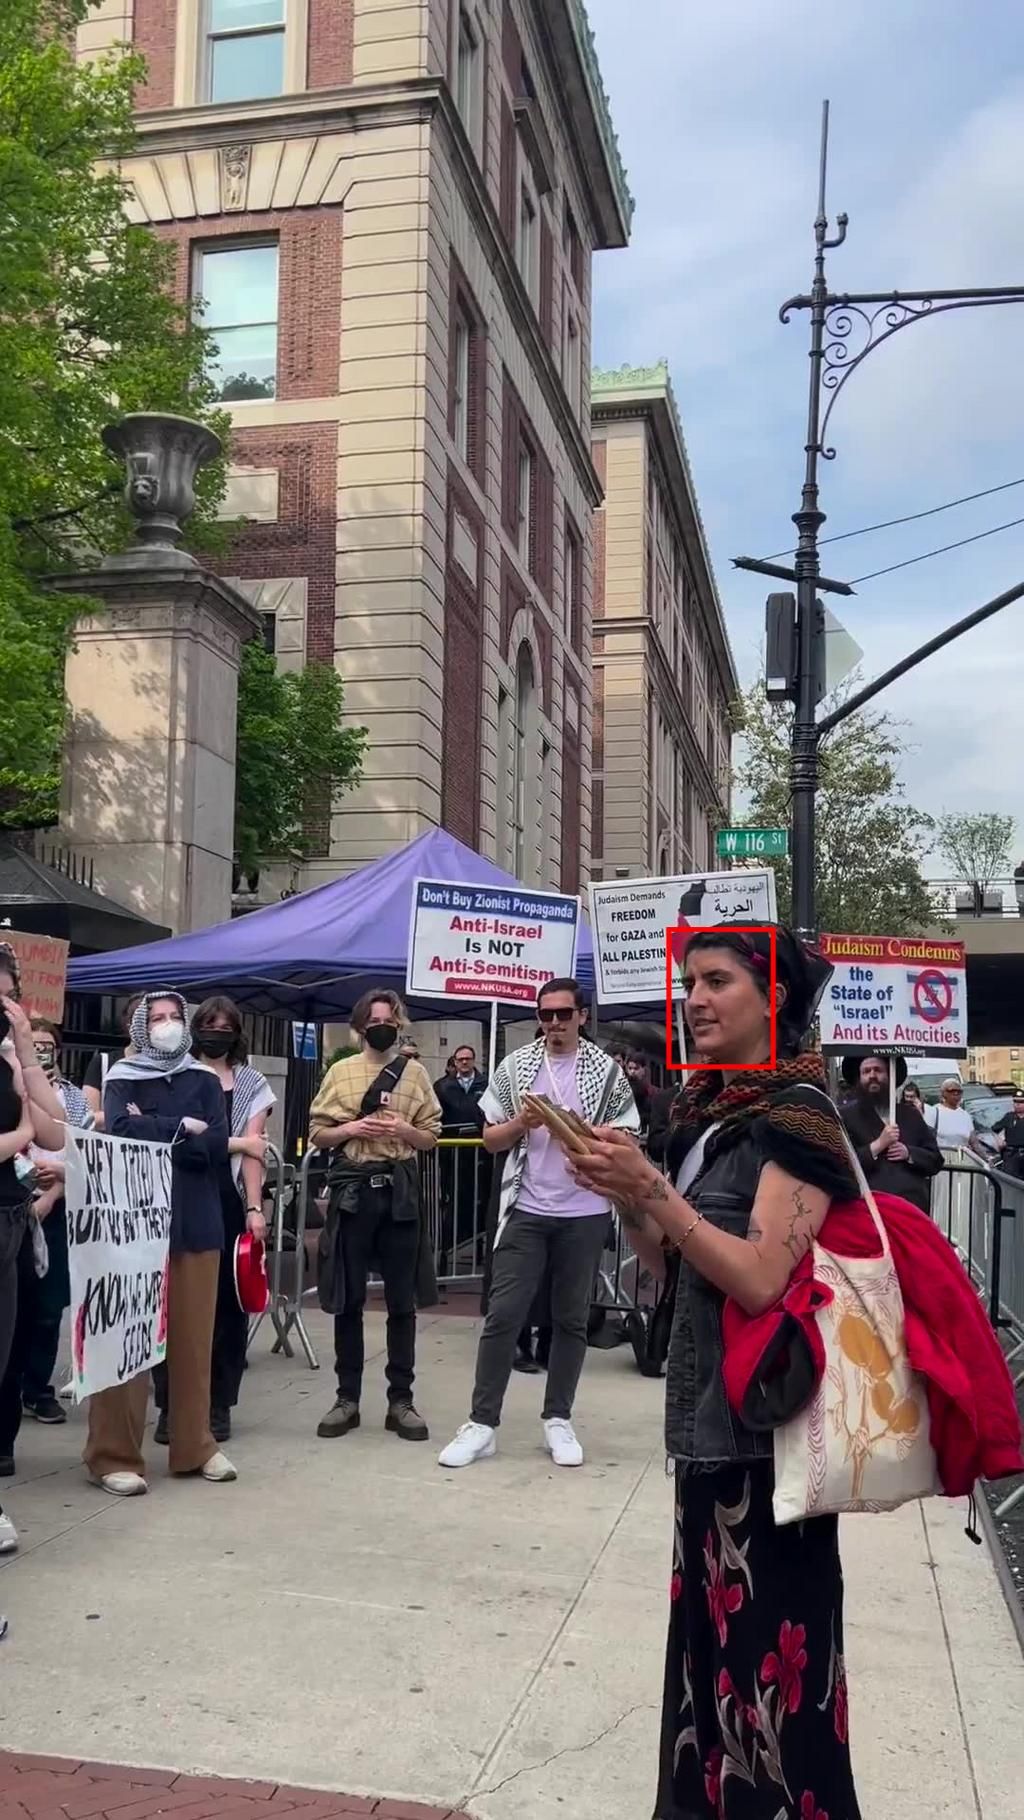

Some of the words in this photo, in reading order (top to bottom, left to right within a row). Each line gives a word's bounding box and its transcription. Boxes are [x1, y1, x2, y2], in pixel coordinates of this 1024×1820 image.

[726, 833, 737, 851] W
[745, 833, 765, 851] 116
[772, 833, 782, 844] St
[422, 887, 449, 905] Don't
[453, 891, 473, 909] Buy
[474, 894, 511, 911] Zionist
[513, 898, 573, 919] Propaganda
[598, 893, 629, 905] Judaism
[630, 890, 666, 902] Demands
[611, 909, 656, 922] FREEDOM
[714, 898, 753, 917] الحرية
[449, 915, 543, 939] Anti-Israel
[606, 932, 619, 943] for
[621, 930, 646, 941] GAZA
[648, 929, 665, 939] and
[465, 938, 481, 953] Is
[489, 940, 525, 957] NOT
[602, 952, 619, 962] ALL
[621, 948, 667, 962] PALESTIN
[824, 936, 884, 956] Judaism
[888, 939, 961, 962] Condemns
[429, 956, 555, 982] Anti-Semitism
[849, 966, 873, 981] the
[454, 982, 528, 998] www.NKUSA.org
[831, 985, 872, 1001] State
[876, 985, 893, 1001] of
[833, 1023, 862, 1040] And
[867, 1024, 888, 1040] its
[894, 1024, 961, 1044] Atrocities
[75, 1138, 115, 1206] THEY
[82, 1271, 127, 1337] KNOW
[117, 1319, 153, 1380] SEEDS
